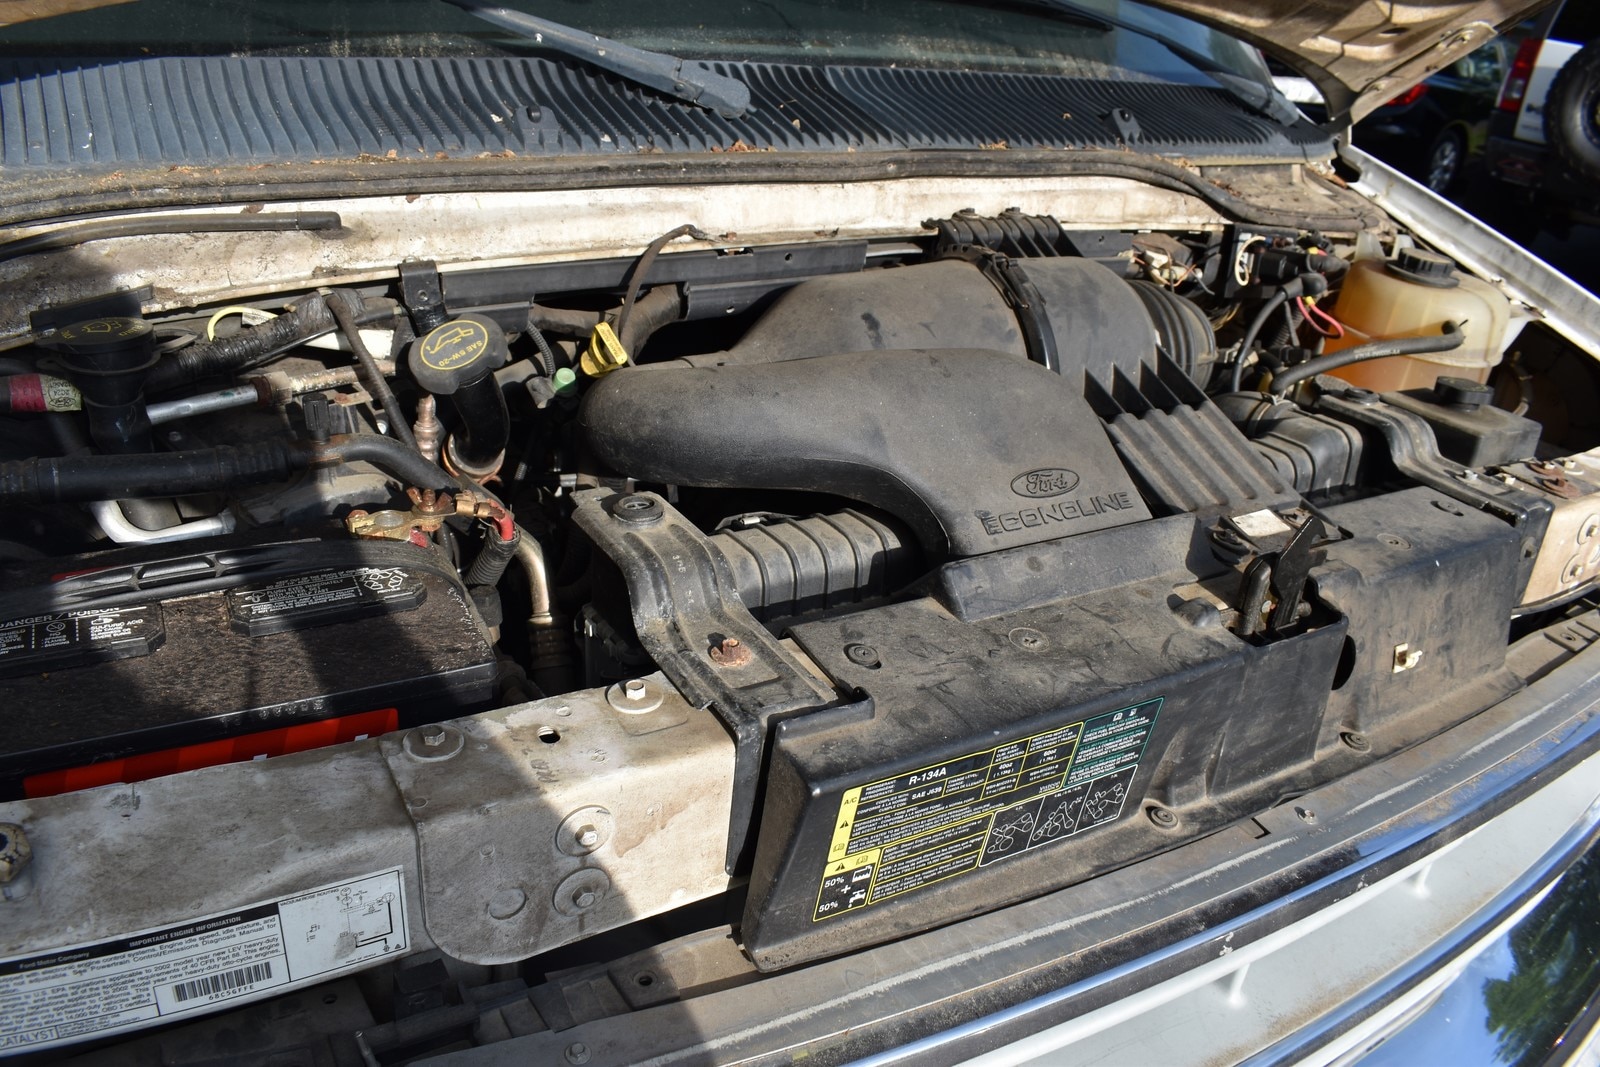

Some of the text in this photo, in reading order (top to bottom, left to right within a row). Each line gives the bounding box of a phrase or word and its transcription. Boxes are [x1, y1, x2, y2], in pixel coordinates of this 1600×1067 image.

[439, 341, 482, 366] SAE 5W-20
[1026, 472, 1067, 493] Ford
[981, 492, 1133, 535] ECONOLINE
[909, 767, 946, 785] R-134A
[844, 797, 857, 805] A/C
[912, 786, 942, 800] SAE J639
[825, 876, 844, 888] 50%
[819, 901, 838, 912] 50%
[102, 954, 126, 962] control
[160, 941, 183, 950] Engine
[199, 932, 220, 940] speed,
[236, 922, 261, 931] mixture,
[129, 916, 241, 947] IMPORTANT ENGINE INFORMATION
[19, 960, 36, 969] Ford
[58, 952, 90, 961] Company
[90, 960, 130, 971] Powertrain
[133, 944, 199, 962] Control/Emissions
[202, 934, 236, 946] Diagnosis
[240, 926, 264, 936] Manual
[109, 971, 143, 981] applicable
[173, 958, 194, 967] model
[244, 937, 278, 949] heavy-duty
[137, 967, 179, 980] requirements
[200, 957, 216, 966] CFR
[259, 943, 280, 952] engine
[185, 964, 219, 976] heavy-duty
[255, 949, 280, 959] engines.
